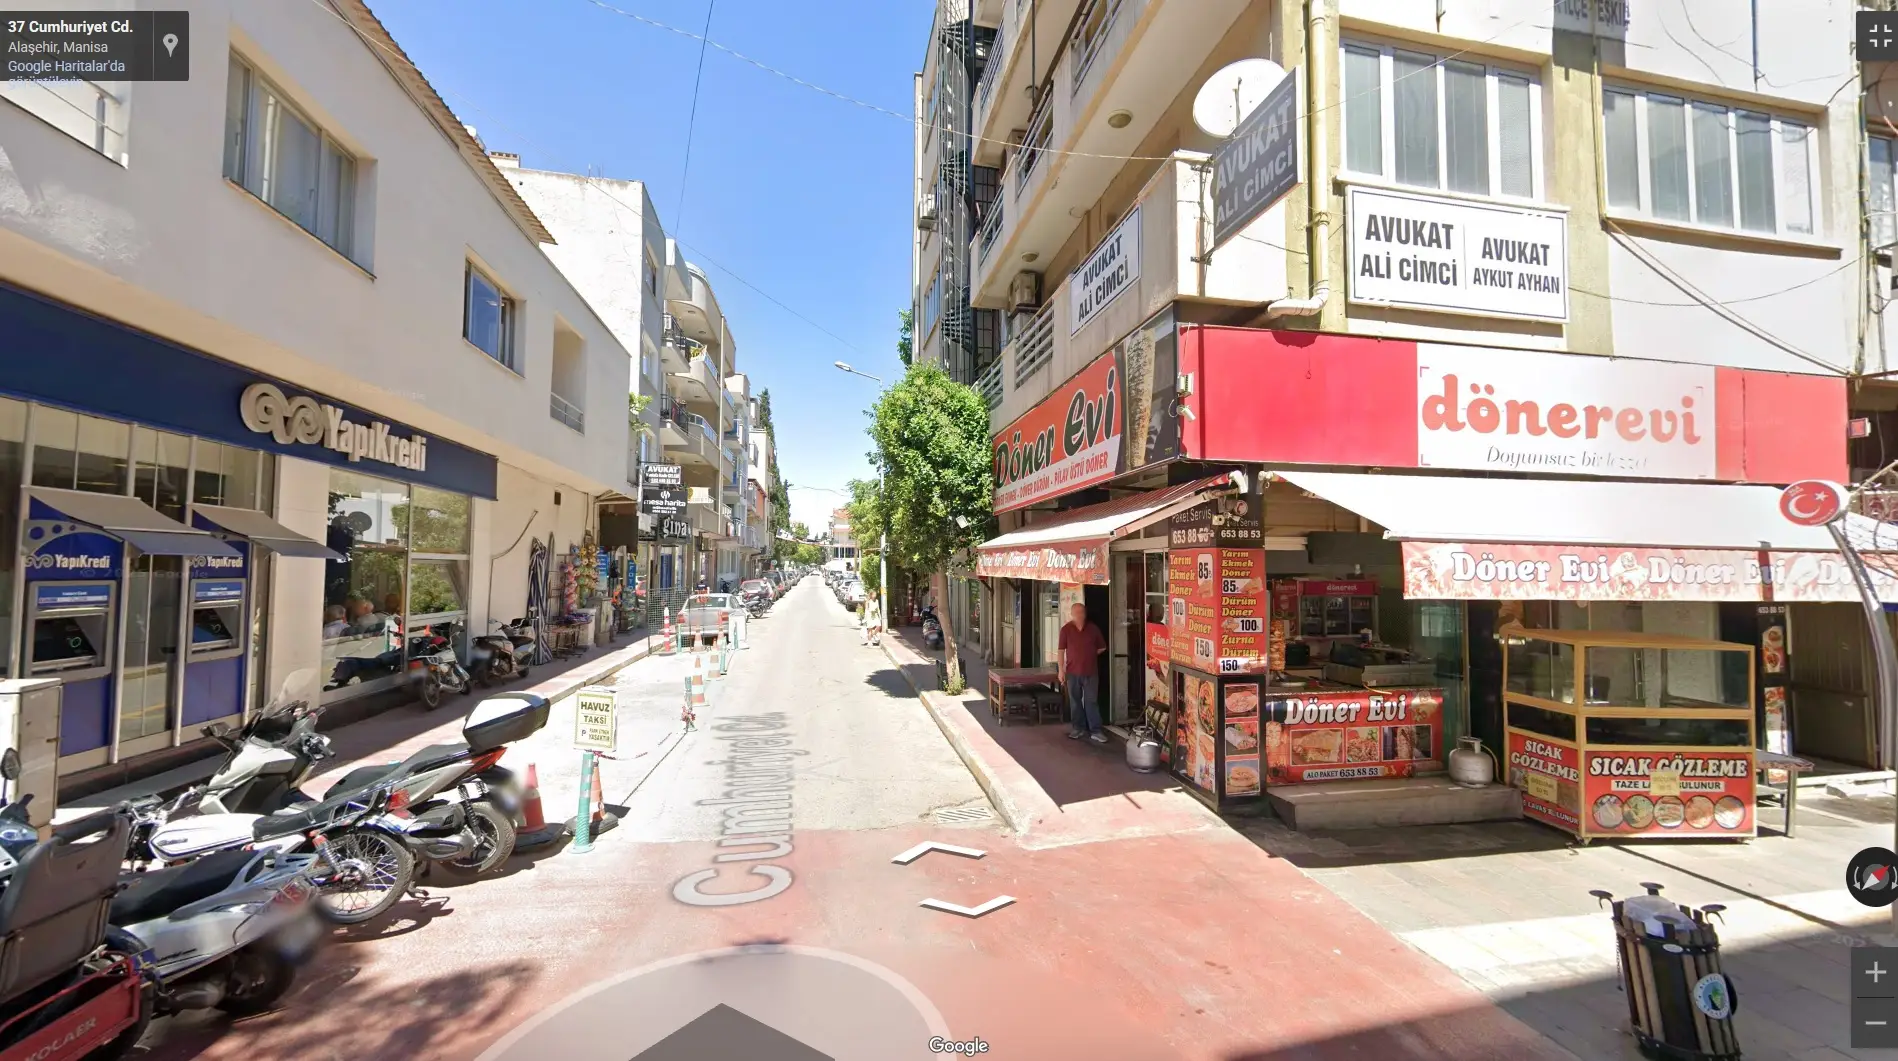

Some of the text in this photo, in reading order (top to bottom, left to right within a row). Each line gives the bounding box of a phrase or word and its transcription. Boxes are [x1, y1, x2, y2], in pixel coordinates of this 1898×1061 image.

[1215, 98, 1293, 196] AVUKAT
[1215, 189, 1239, 227] ALİ
[1365, 213, 1454, 250] AVUKAT
[1082, 233, 1123, 291] AVUKAT
[1482, 237, 1550, 267] AVUKAT
[1360, 251, 1458, 287] ALİ CİMCİ
[1078, 255, 1129, 322] ALİ CİMCİ
[1473, 267, 1560, 294] AYKUT AYHAN
[1422, 373, 1702, 446] dönerevi
[323, 404, 428, 472] YapıKredi
[995, 367, 1116, 489] Döner Evi
[1486, 445, 1577, 468] Doyumsuz
[1190, 506, 1212, 523] Servis
[1172, 529, 1187, 544] 653
[1187, 528, 1197, 543] 88
[1221, 530, 1261, 538] 653 88 53
[54, 554, 111, 570] YapıKredi
[1170, 555, 1192, 565] Yarım
[1221, 559, 1254, 567] Ekmek
[1222, 549, 1250, 558] Yarım
[1170, 568, 1196, 580] Ekmek
[1450, 551, 1551, 582] Döner
[1559, 553, 1611, 584] Evi
[1648, 555, 1736, 586] Döner
[1742, 558, 1786, 587] Evi
[1221, 596, 1257, 606] Dürüm
[1221, 607, 1254, 617] Döner
[1221, 634, 1255, 645] Zurna
[580, 701, 610, 712] HAVUZ
[1284, 694, 1408, 726] Döner Evi
[583, 715, 607, 725] TAKSİ
[1525, 740, 1563, 760] SICAK
[1306, 766, 1379, 779] ALO PAKET 653 88 53
[1511, 752, 1579, 782] GÖZLEME
[1589, 754, 1749, 778] SICAK GÖZLEME
[1615, 780, 1640, 790] TAZE
